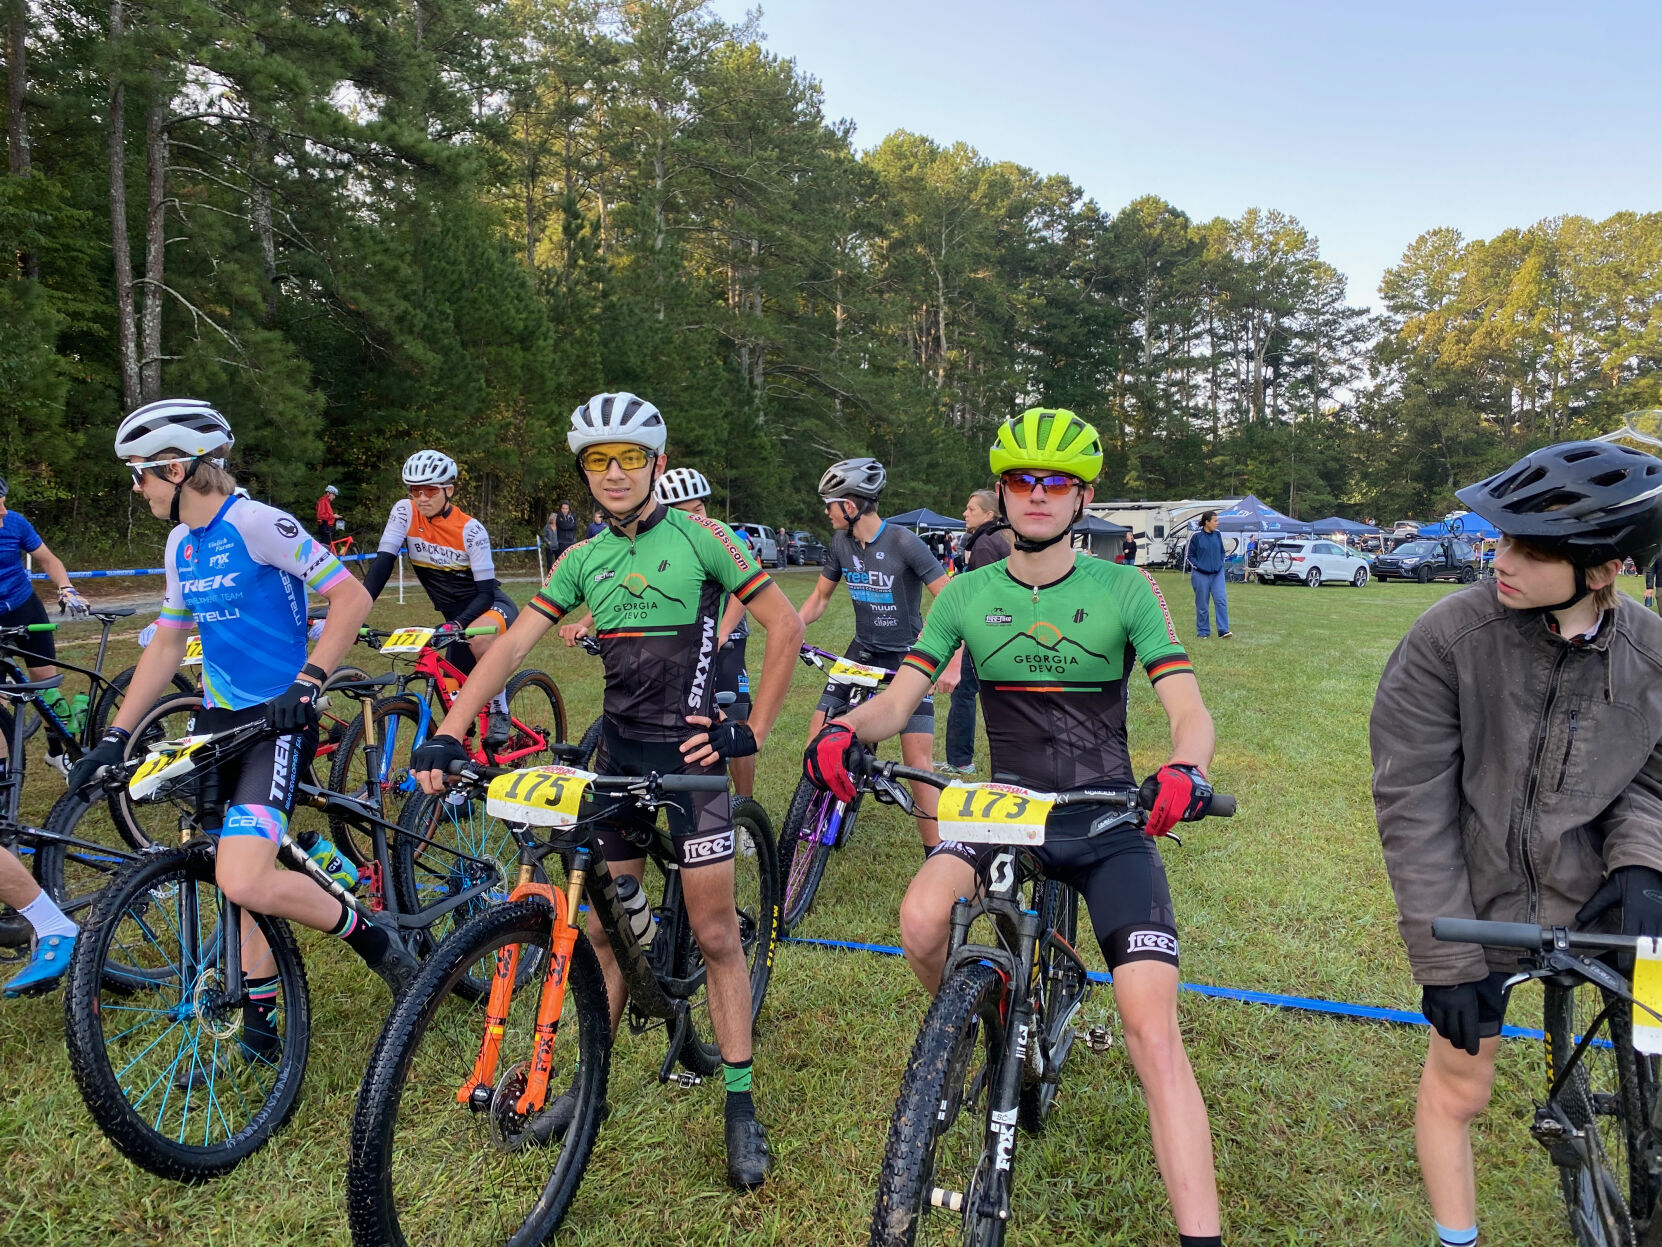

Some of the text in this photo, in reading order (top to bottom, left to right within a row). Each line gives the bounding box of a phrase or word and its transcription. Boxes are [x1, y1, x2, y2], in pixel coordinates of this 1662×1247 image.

[688, 514, 749, 571] esigrips.com
[179, 572, 242, 594] TREK
[613, 601, 658, 613] GEORGIA
[391, 634, 420, 647] 171
[687, 615, 716, 709] MAXXIS
[1014, 655, 1079, 666] GEORGIA
[1029, 664, 1066, 675] DEVO
[505, 773, 571, 807] 175
[958, 789, 1030, 819] 173
[328, 857, 341, 872] GU
